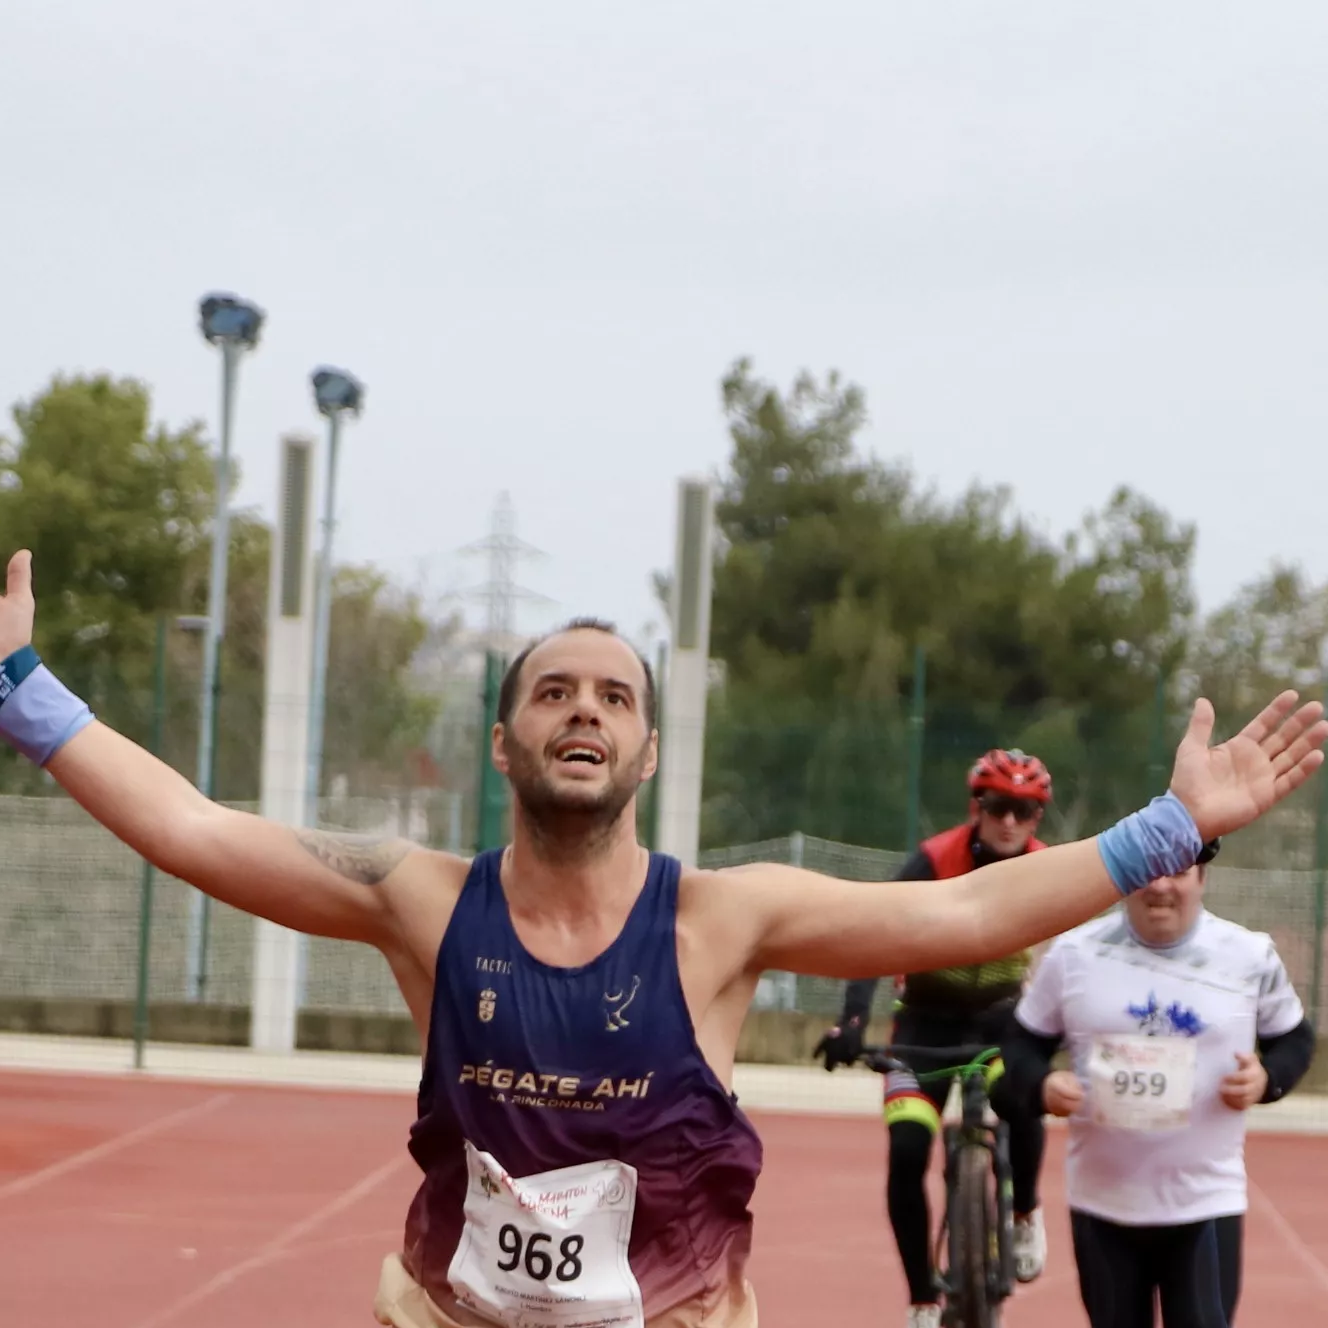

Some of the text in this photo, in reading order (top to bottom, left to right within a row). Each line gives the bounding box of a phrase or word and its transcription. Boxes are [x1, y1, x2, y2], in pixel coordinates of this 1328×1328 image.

[476, 956, 512, 975] TACTIC
[458, 1060, 655, 1098] PÉGATE AHÍ
[1114, 1070, 1167, 1098] 959
[511, 1095, 606, 1111] RINCONADA
[497, 1222, 584, 1282] 968
